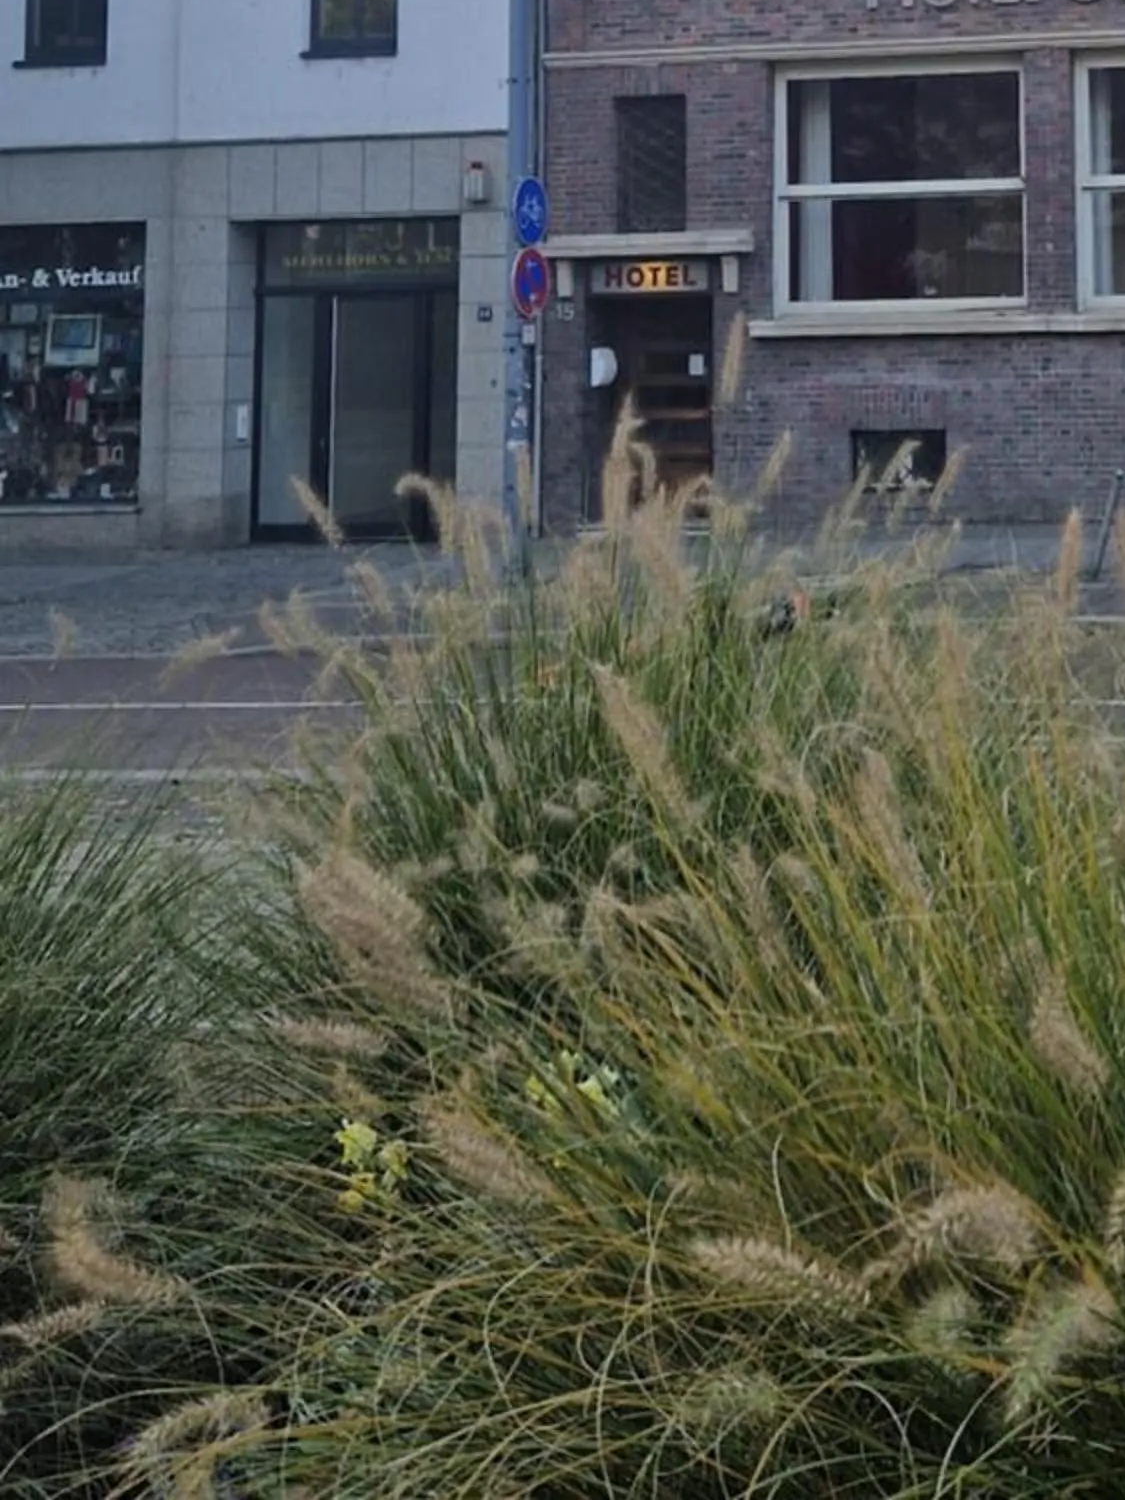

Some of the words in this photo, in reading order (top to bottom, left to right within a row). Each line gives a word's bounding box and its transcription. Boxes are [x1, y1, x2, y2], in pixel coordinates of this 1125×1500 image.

[0, 273, 27, 289] n-
[32, 267, 50, 288] &
[56, 265, 142, 287] Verkauf
[604, 264, 698, 288] HOTEL
[556, 301, 575, 320] 15
